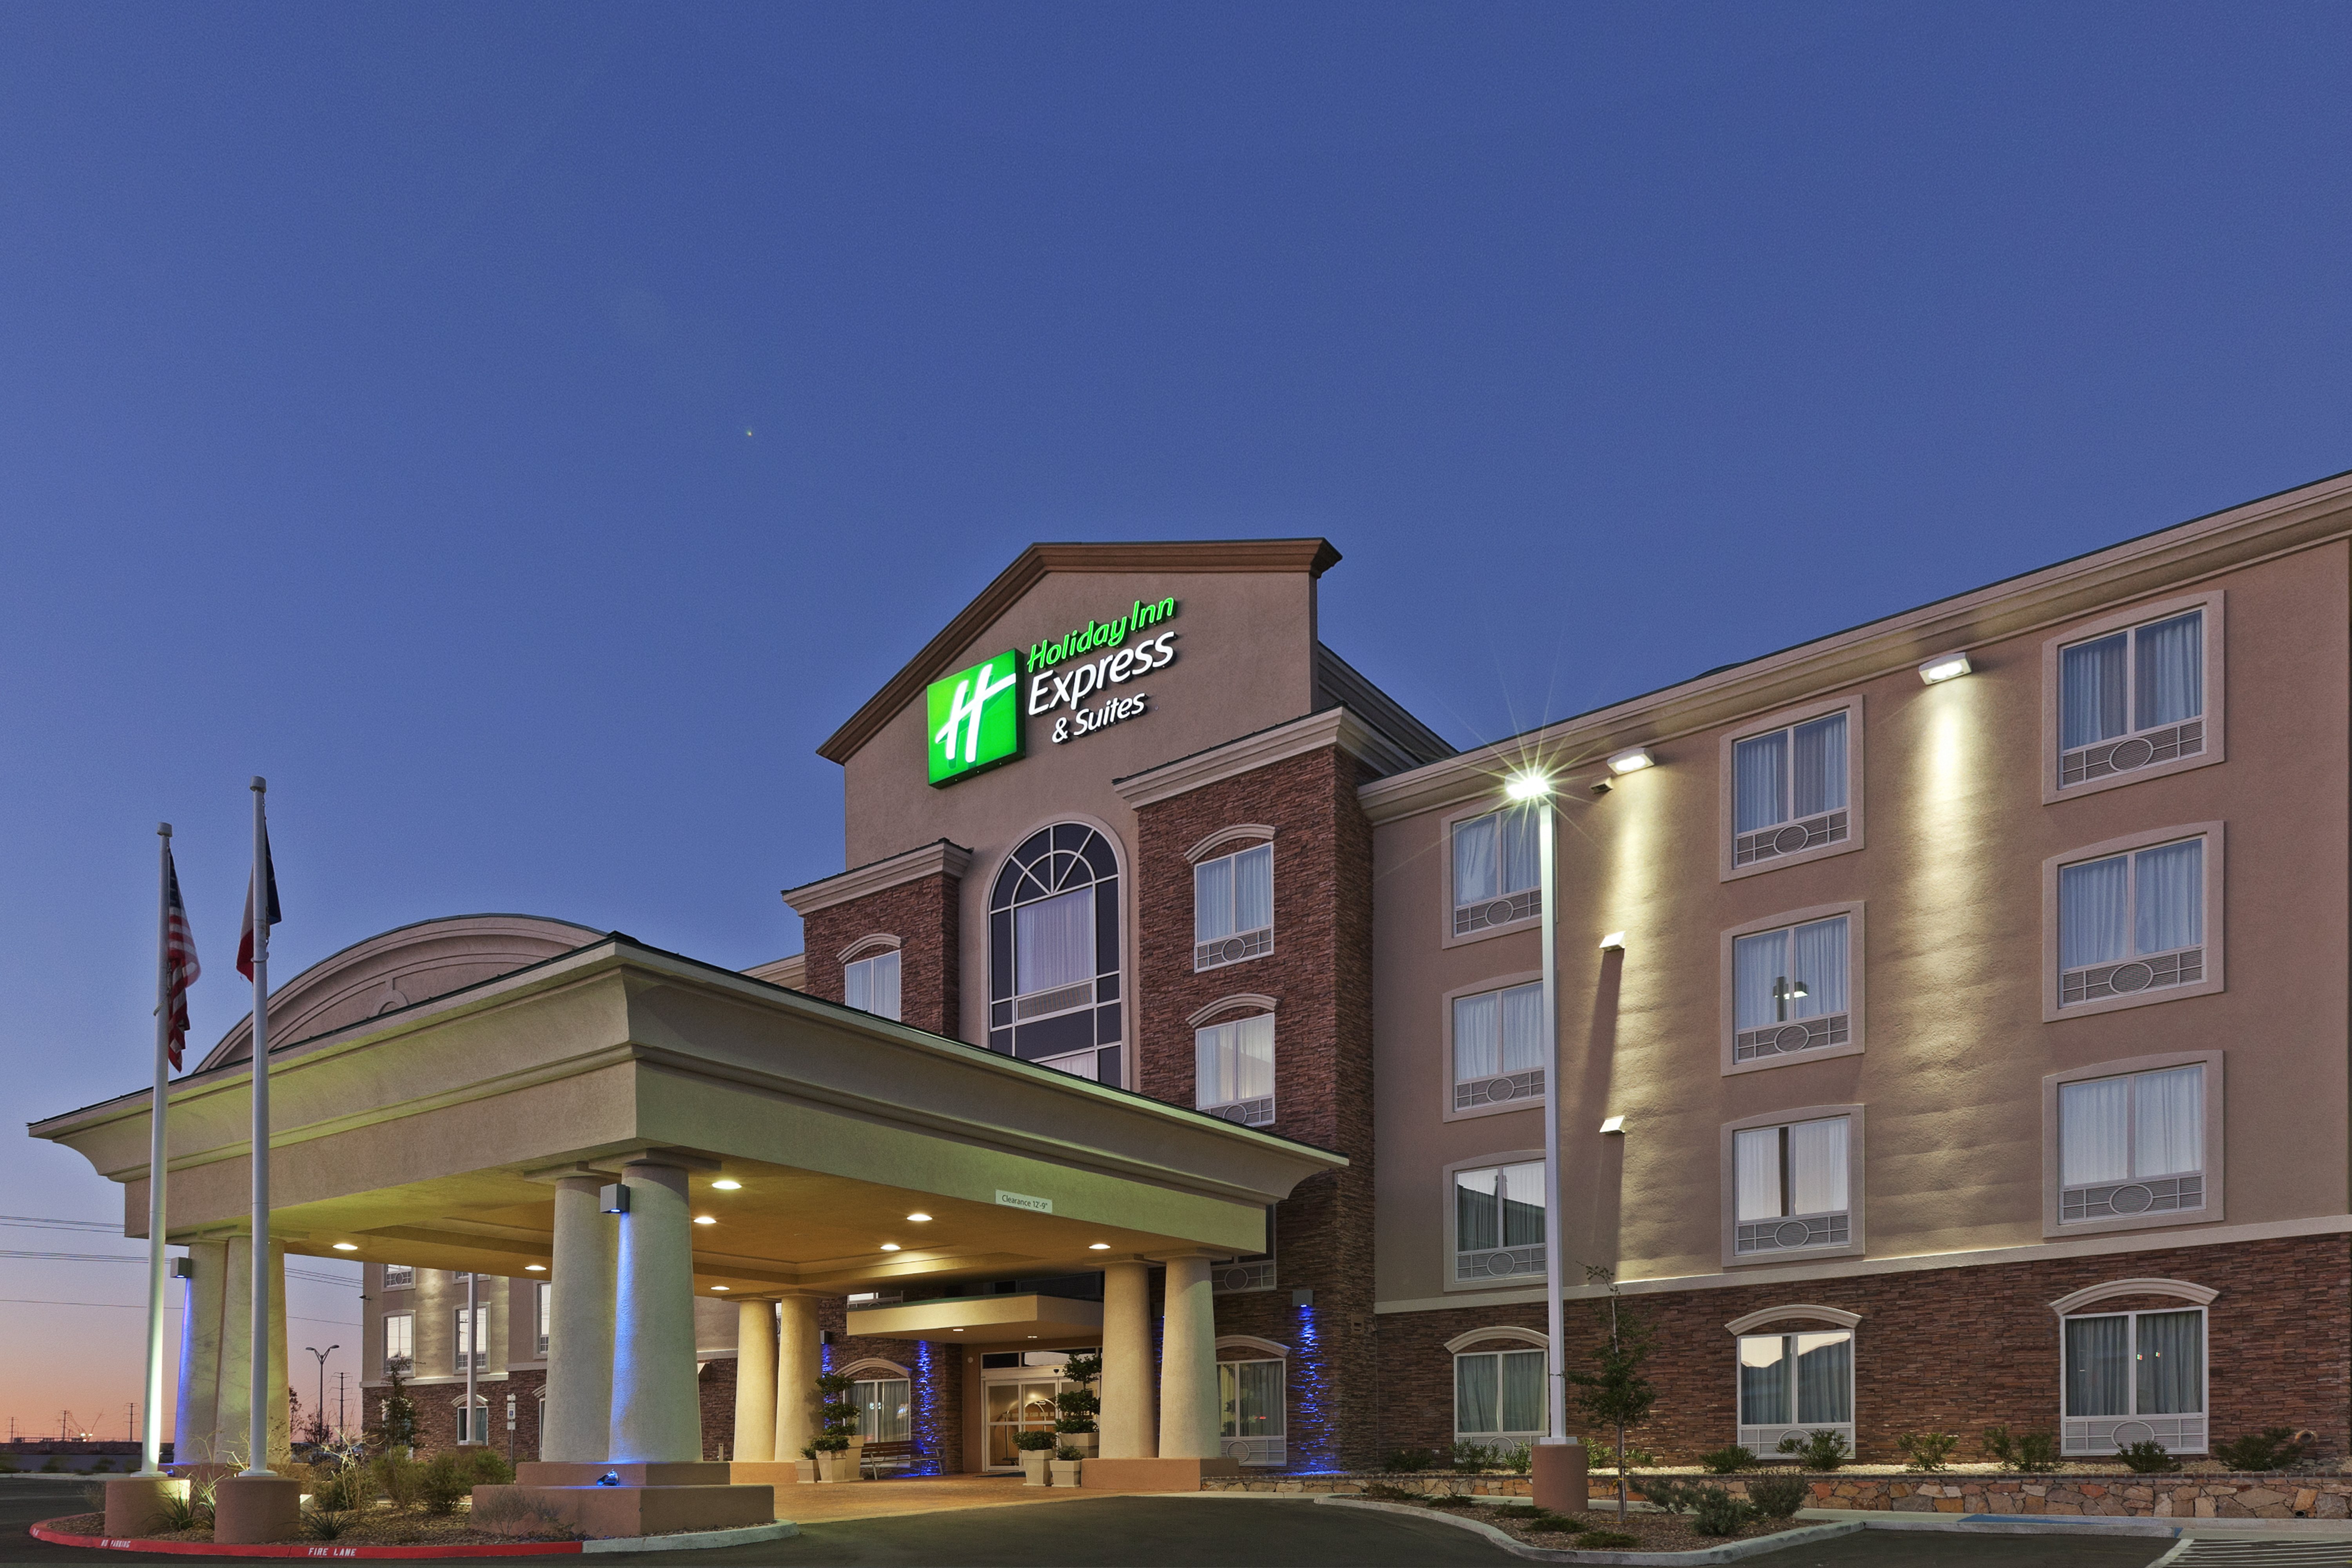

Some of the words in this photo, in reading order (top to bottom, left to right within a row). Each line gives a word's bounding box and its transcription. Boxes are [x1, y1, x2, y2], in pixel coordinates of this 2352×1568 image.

[1027, 616, 1127, 673] Holiday
[1131, 597, 1174, 631] Inn
[1028, 631, 1174, 716] Express
[1052, 717, 1068, 743] &
[1073, 693, 1145, 736] Suites
[1002, 1195, 1031, 1207] Clearance
[110, 1540, 131, 1548] PARKING
[308, 1547, 328, 1556] FIRE
[333, 1548, 357, 1557] LANE
